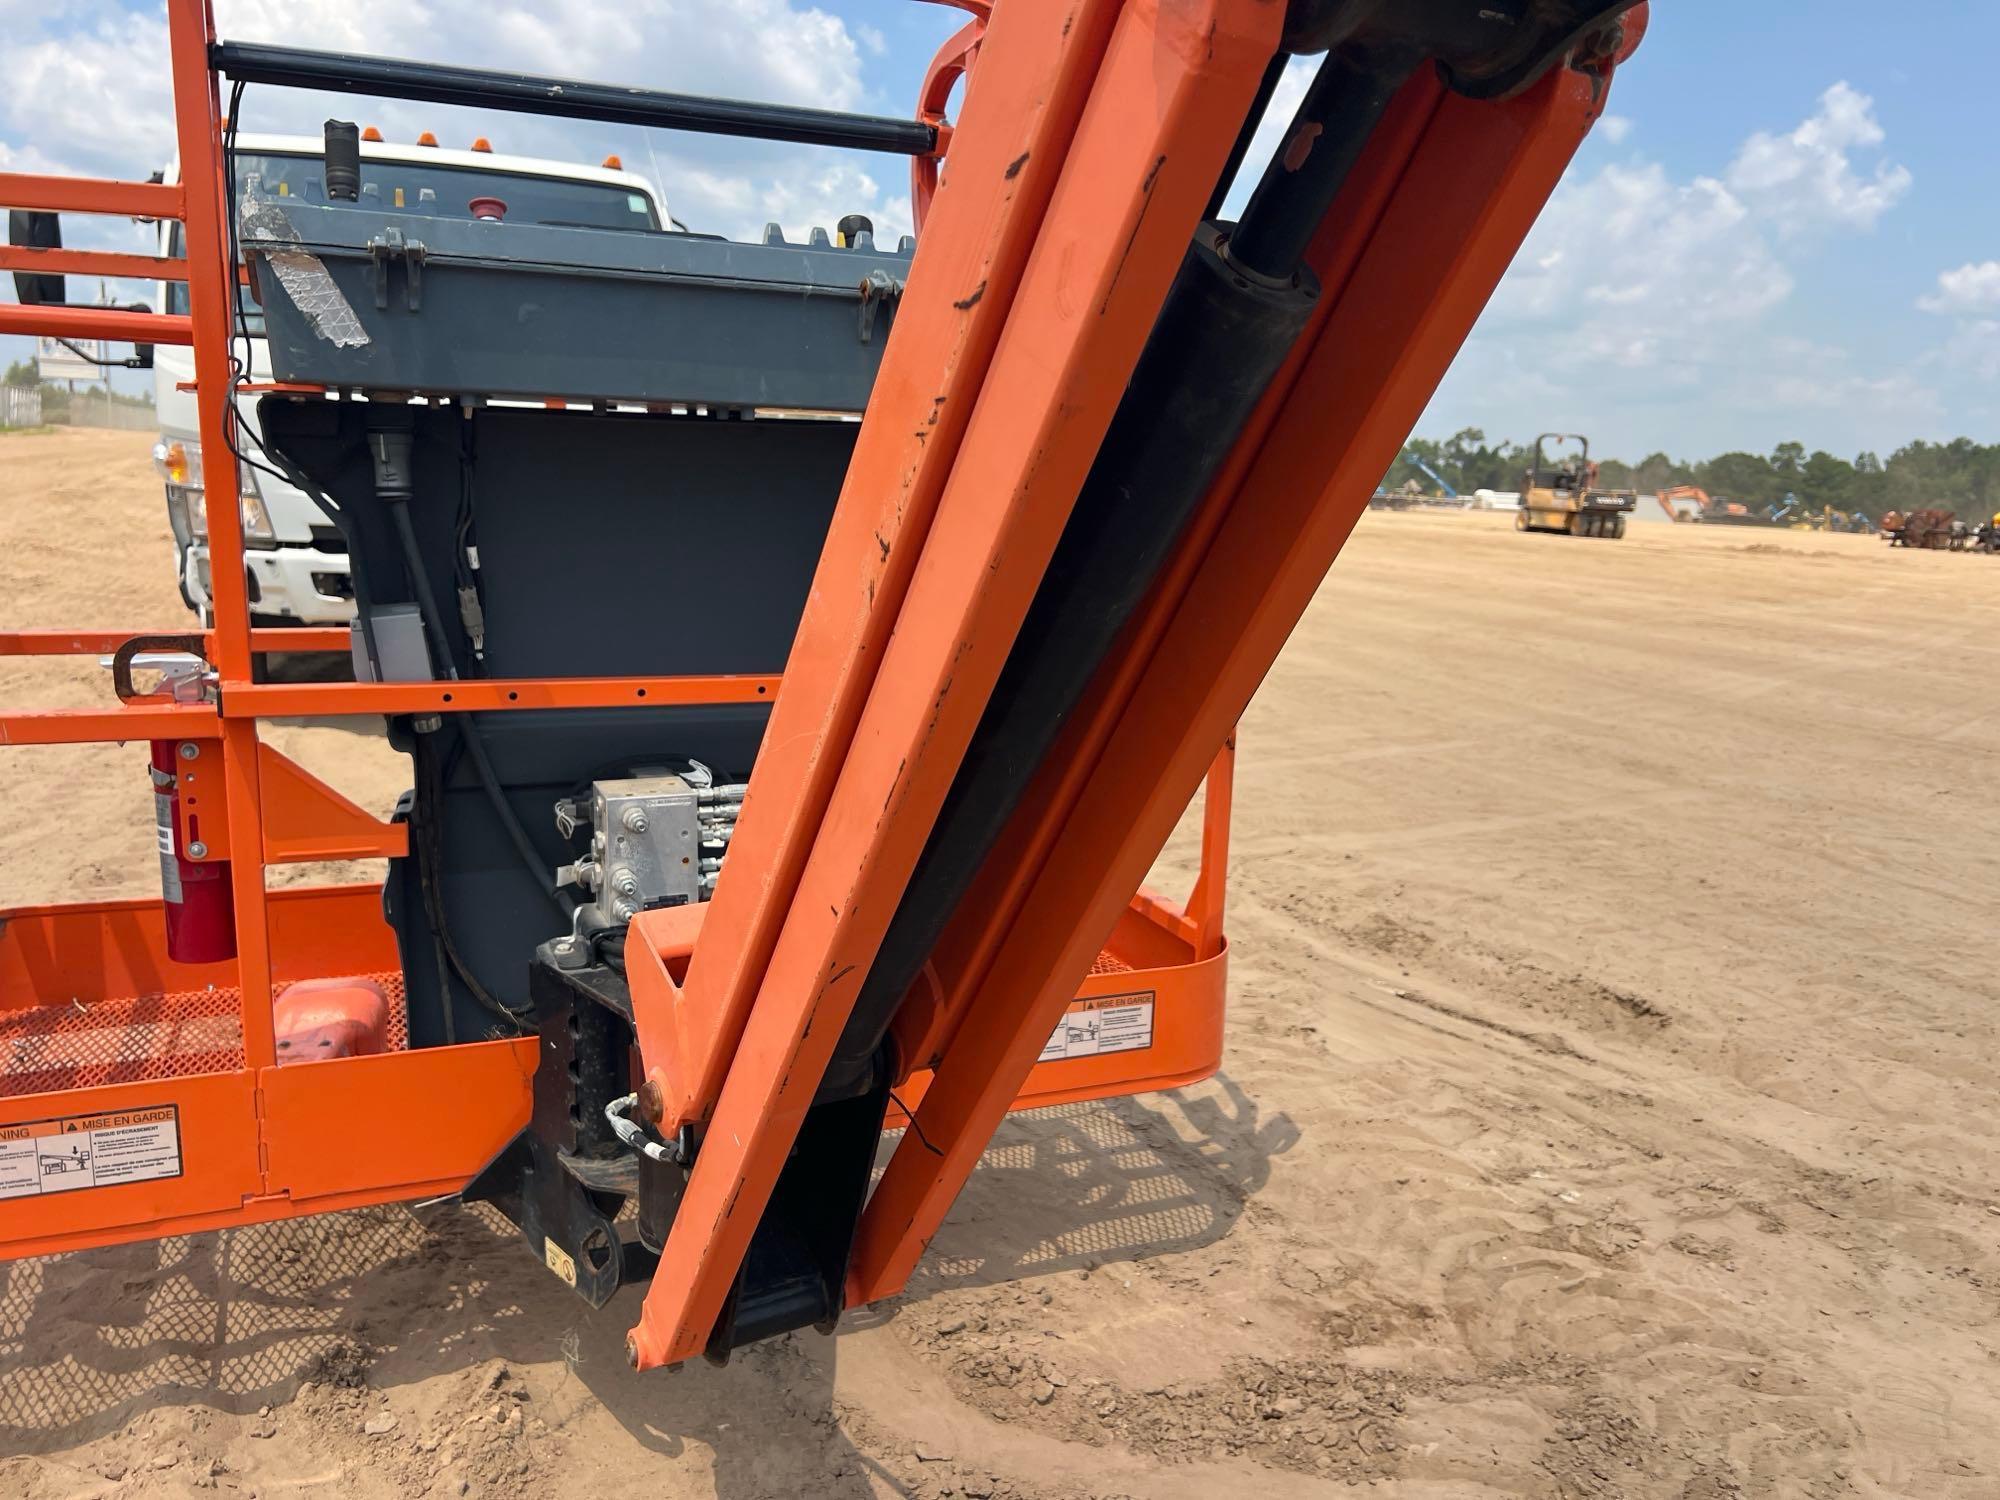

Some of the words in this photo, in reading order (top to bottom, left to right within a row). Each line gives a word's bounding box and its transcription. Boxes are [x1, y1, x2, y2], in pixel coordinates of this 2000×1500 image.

[1096, 999, 1115, 1008] MISE
[1115, 997, 1126, 1005] EN
[1127, 995, 1152, 1005] GARDE
[82, 1117, 111, 1130] MISE
[114, 1115, 130, 1126] EN
[133, 1109, 174, 1124] GARDE
